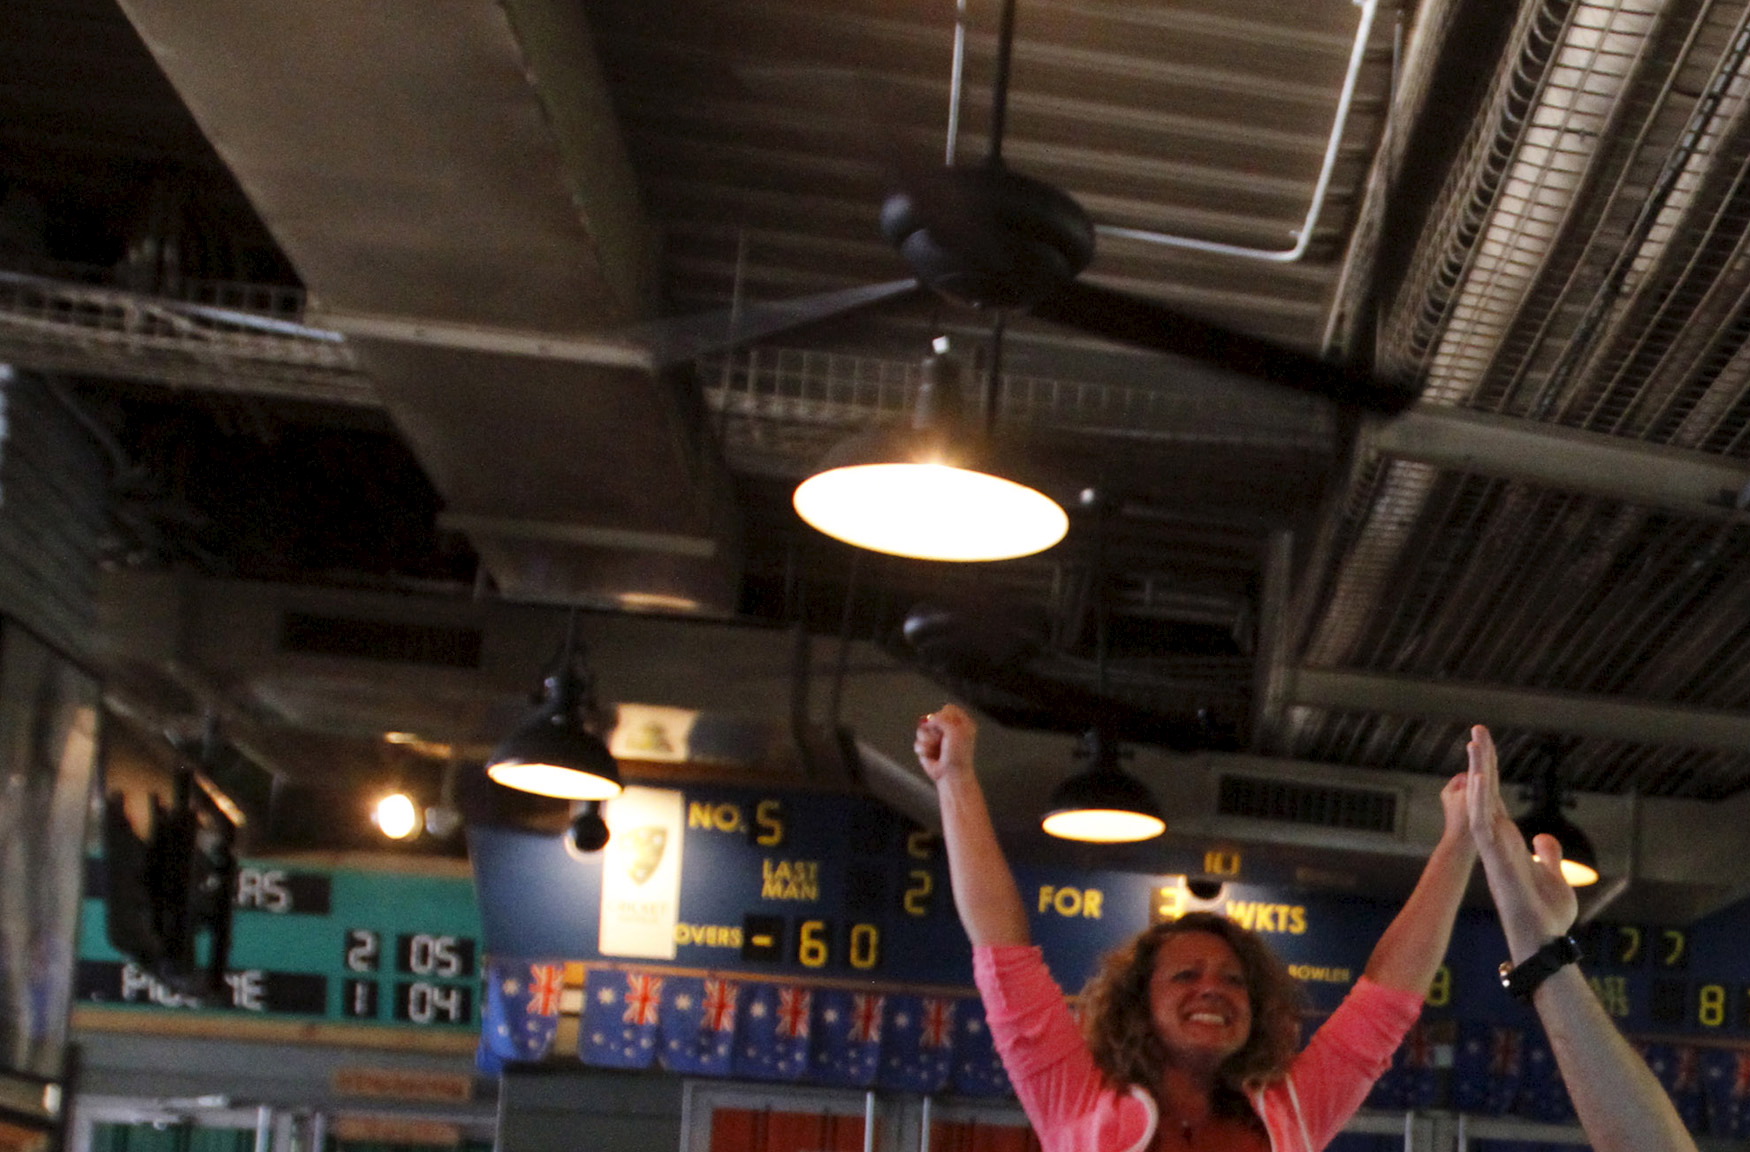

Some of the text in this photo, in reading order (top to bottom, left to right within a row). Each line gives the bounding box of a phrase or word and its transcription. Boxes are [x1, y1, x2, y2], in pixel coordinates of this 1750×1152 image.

[688, 802, 747, 834] NO.
[762, 858, 820, 883] LAST
[761, 879, 820, 901] MAN
[1038, 884, 1104, 919] FOR
[1226, 899, 1308, 935] WKTS
[675, 923, 744, 949] OVERS
[346, 930, 462, 977] 2 05
[407, 982, 461, 1025] 04
